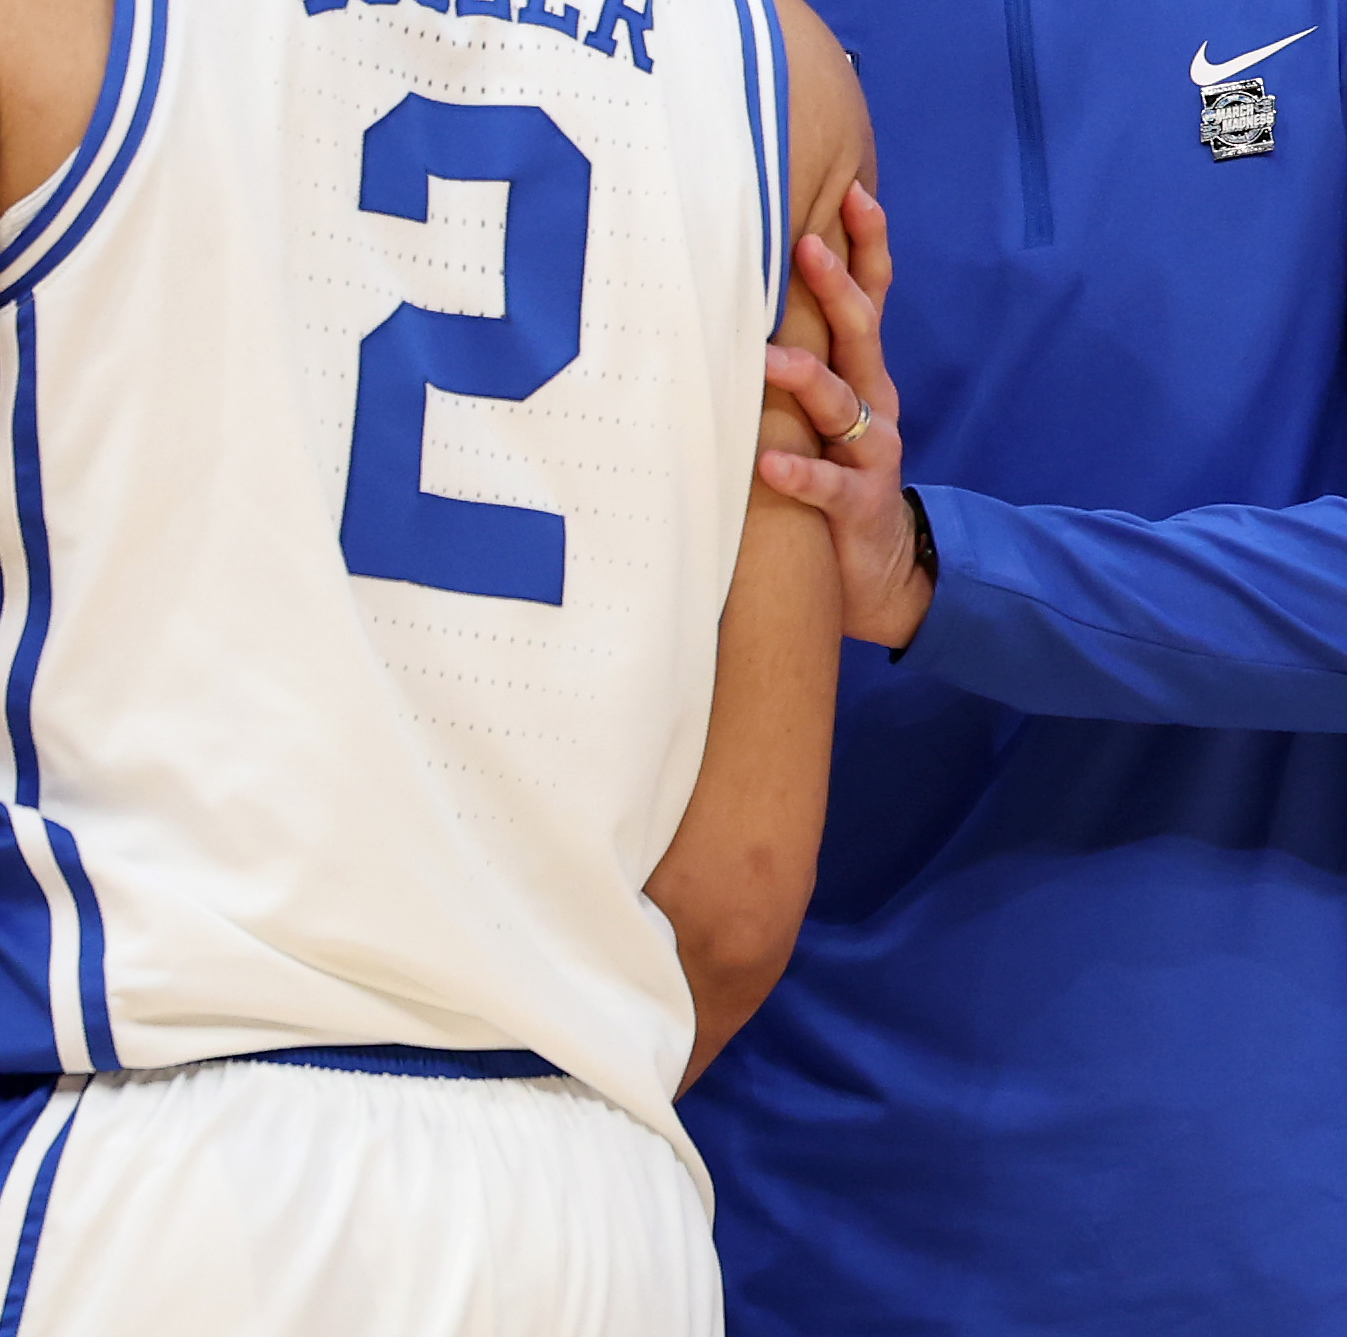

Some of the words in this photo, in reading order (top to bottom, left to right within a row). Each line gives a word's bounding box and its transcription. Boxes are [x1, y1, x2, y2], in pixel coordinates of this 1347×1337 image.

[1216, 103, 1254, 123] MARCH
[1222, 113, 1274, 133] MADNESS
[339, 91, 592, 607] 2
